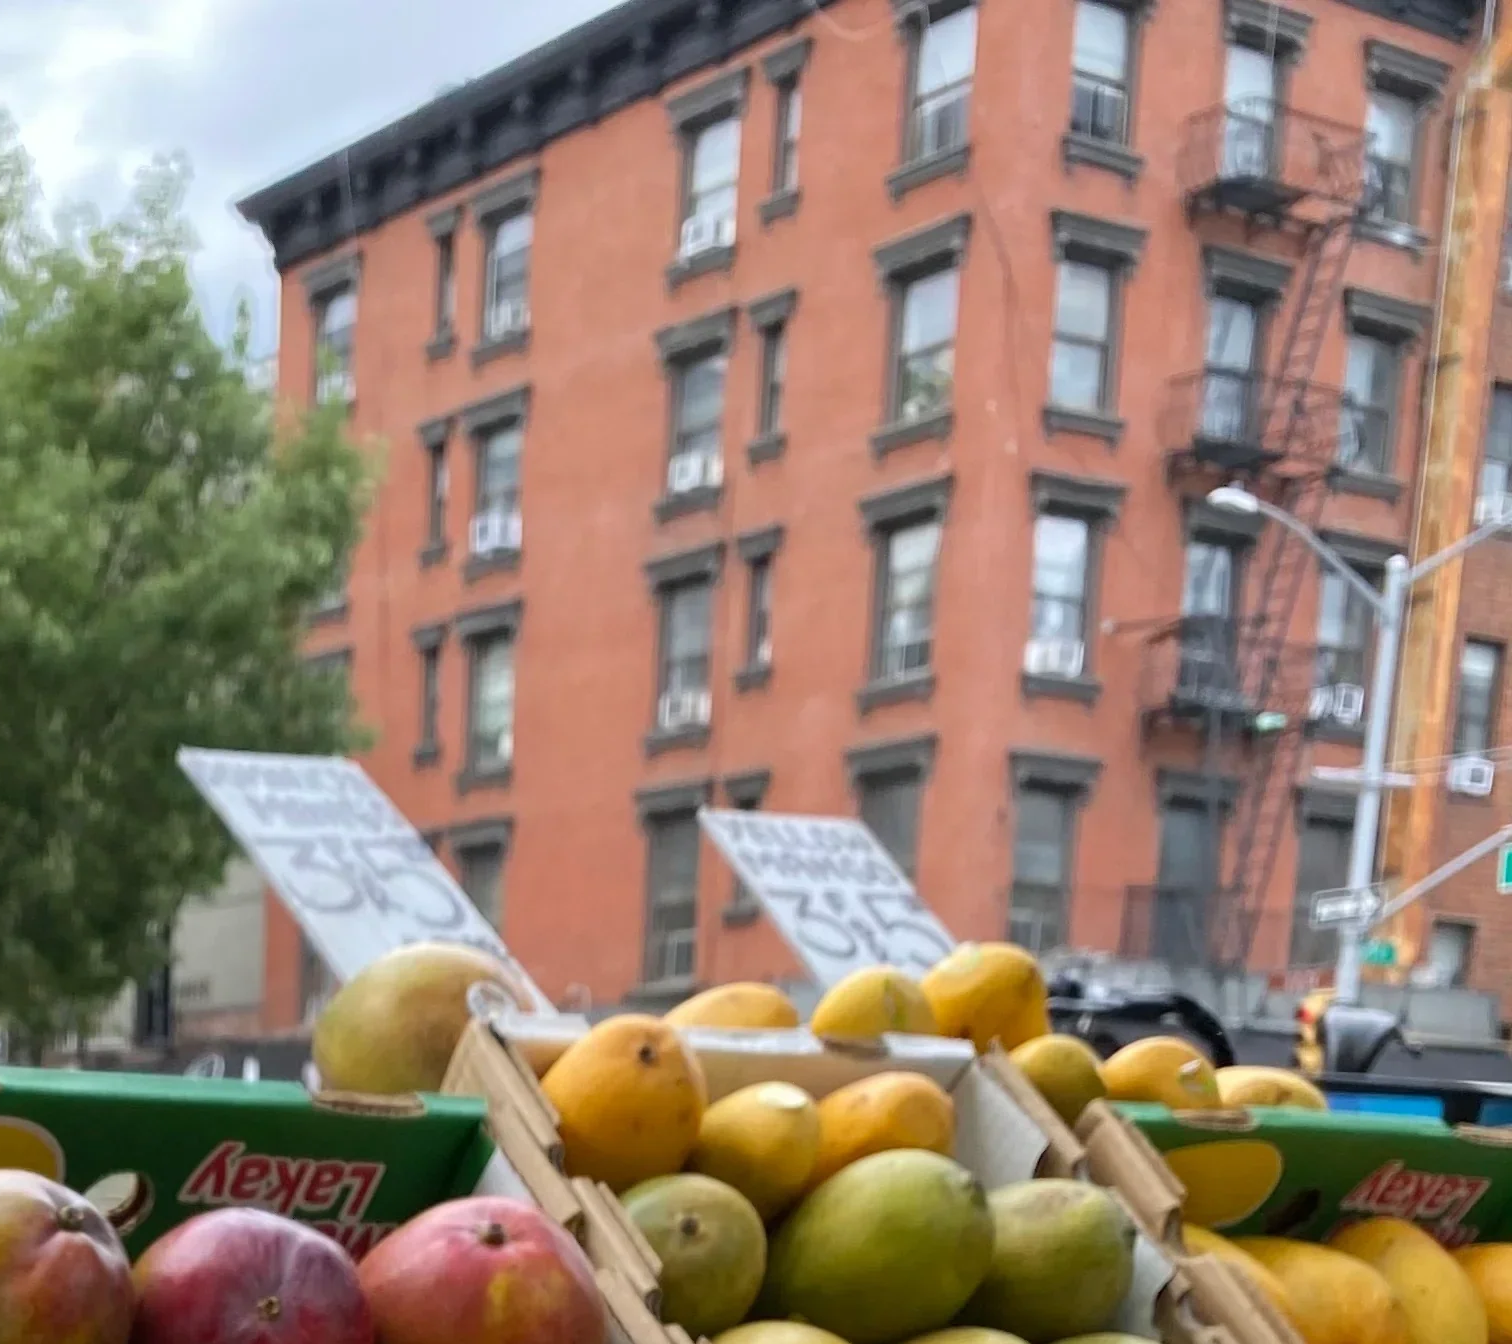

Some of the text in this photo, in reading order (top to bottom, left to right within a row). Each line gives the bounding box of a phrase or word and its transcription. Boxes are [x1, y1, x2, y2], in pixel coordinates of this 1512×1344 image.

[762, 888, 858, 960] 3
[177, 1140, 386, 1222] Lakay
[1340, 1160, 1492, 1226] Lakay
